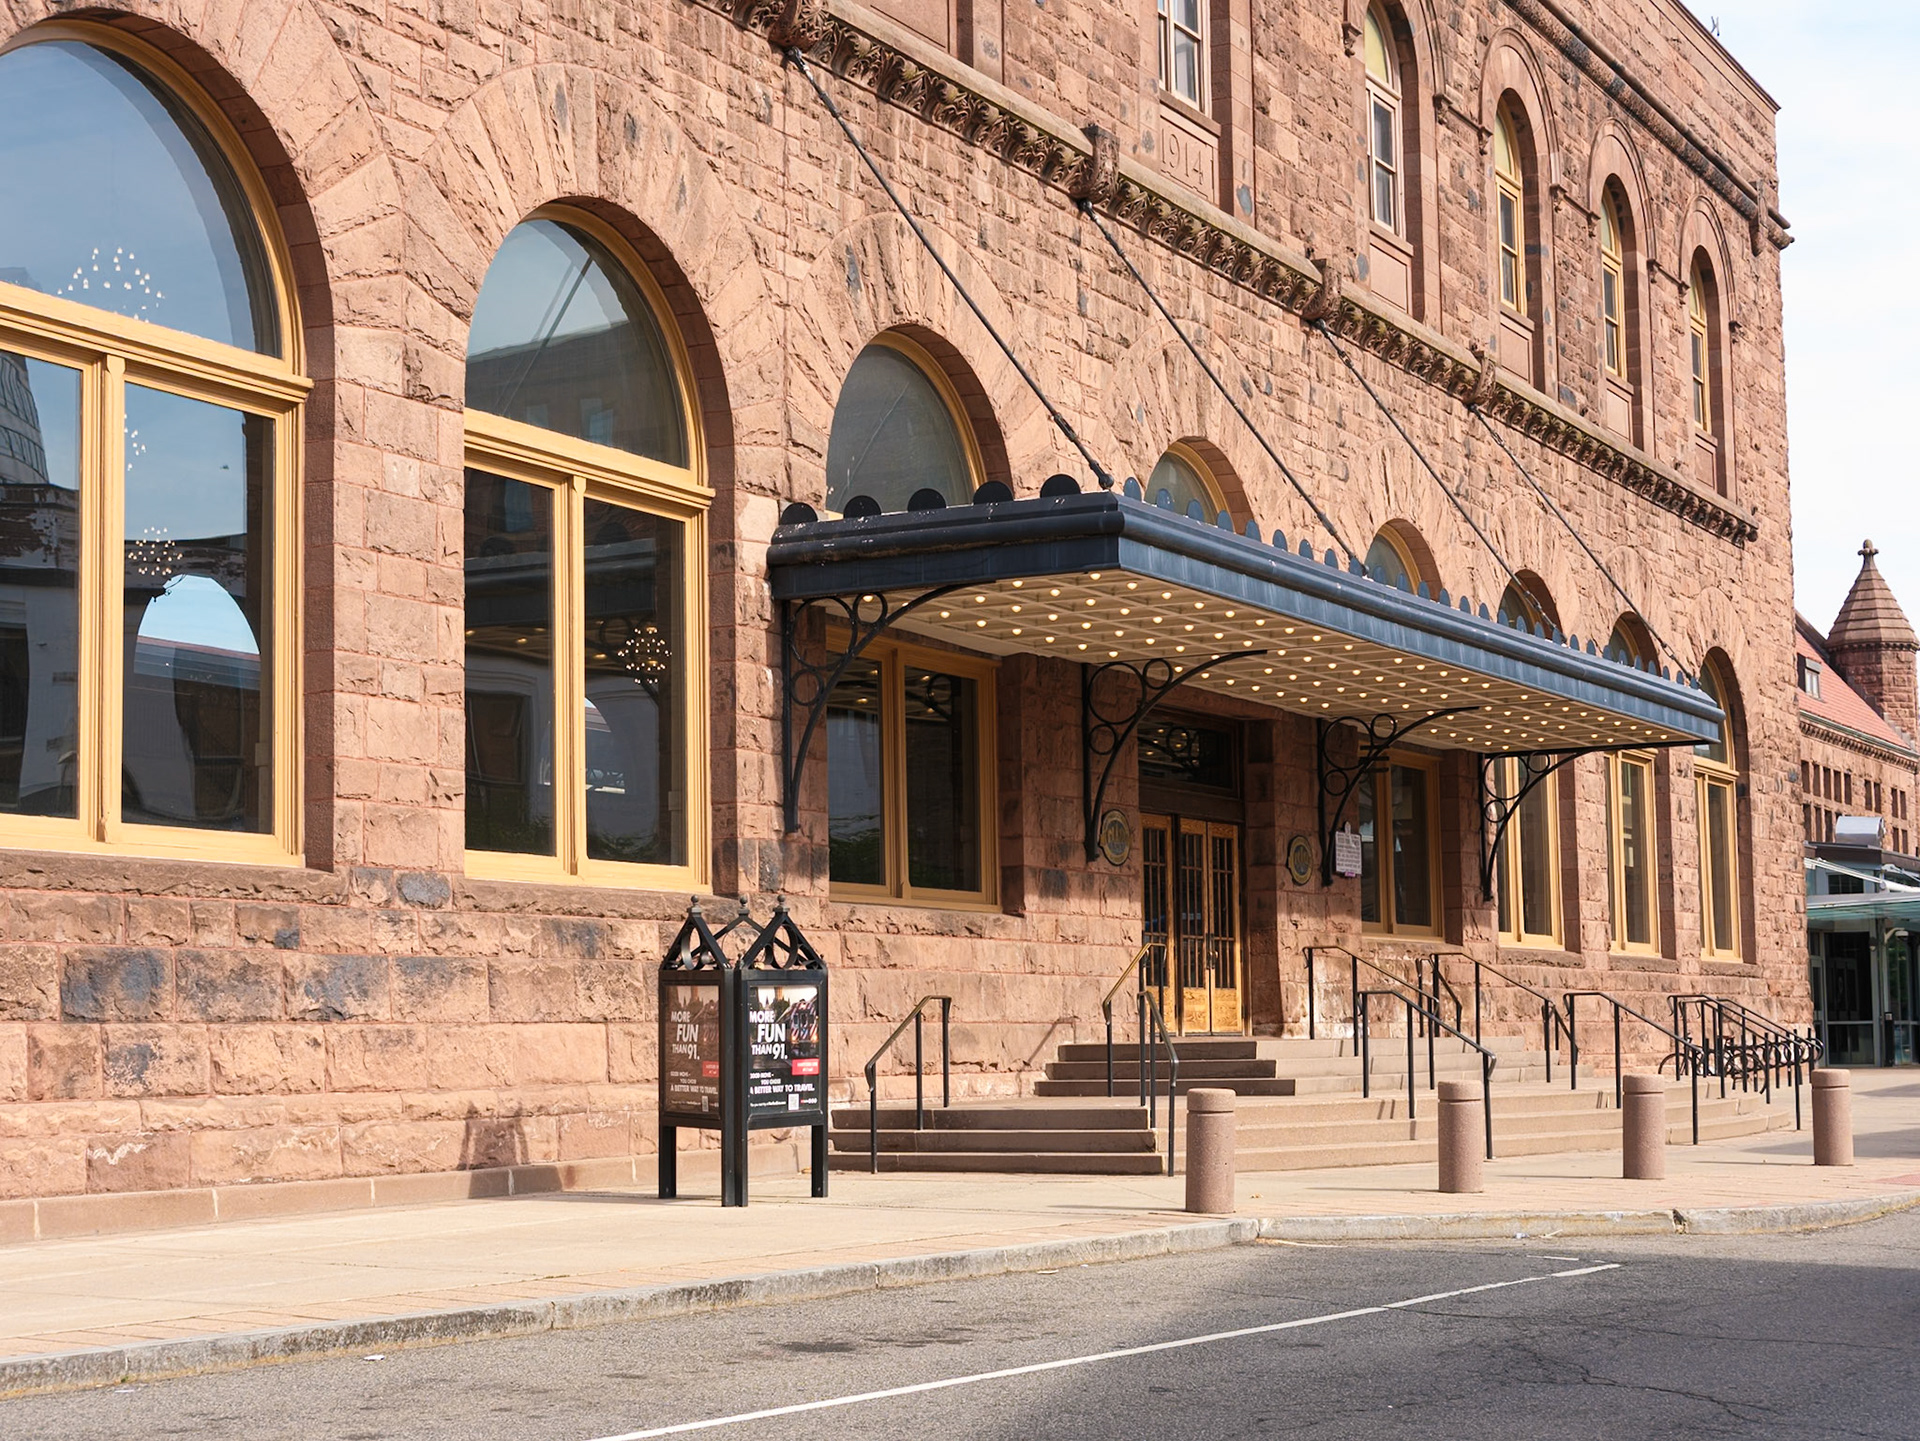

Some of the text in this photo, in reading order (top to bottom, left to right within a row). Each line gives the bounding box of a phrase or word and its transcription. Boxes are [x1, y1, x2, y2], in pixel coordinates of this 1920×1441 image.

[1161, 128, 1203, 186] 1914
[671, 1011, 690, 1022] MORE
[749, 1010, 775, 1023] MORE
[676, 1024, 699, 1042] FUN
[757, 1023, 786, 1043] FUN
[672, 1043, 700, 1060] THAN 91.
[751, 1043, 788, 1060] THAN 91.
[754, 1085, 772, 1095] BETTER
[772, 1085, 784, 1093] WAY
[785, 1084, 793, 1092] TO
